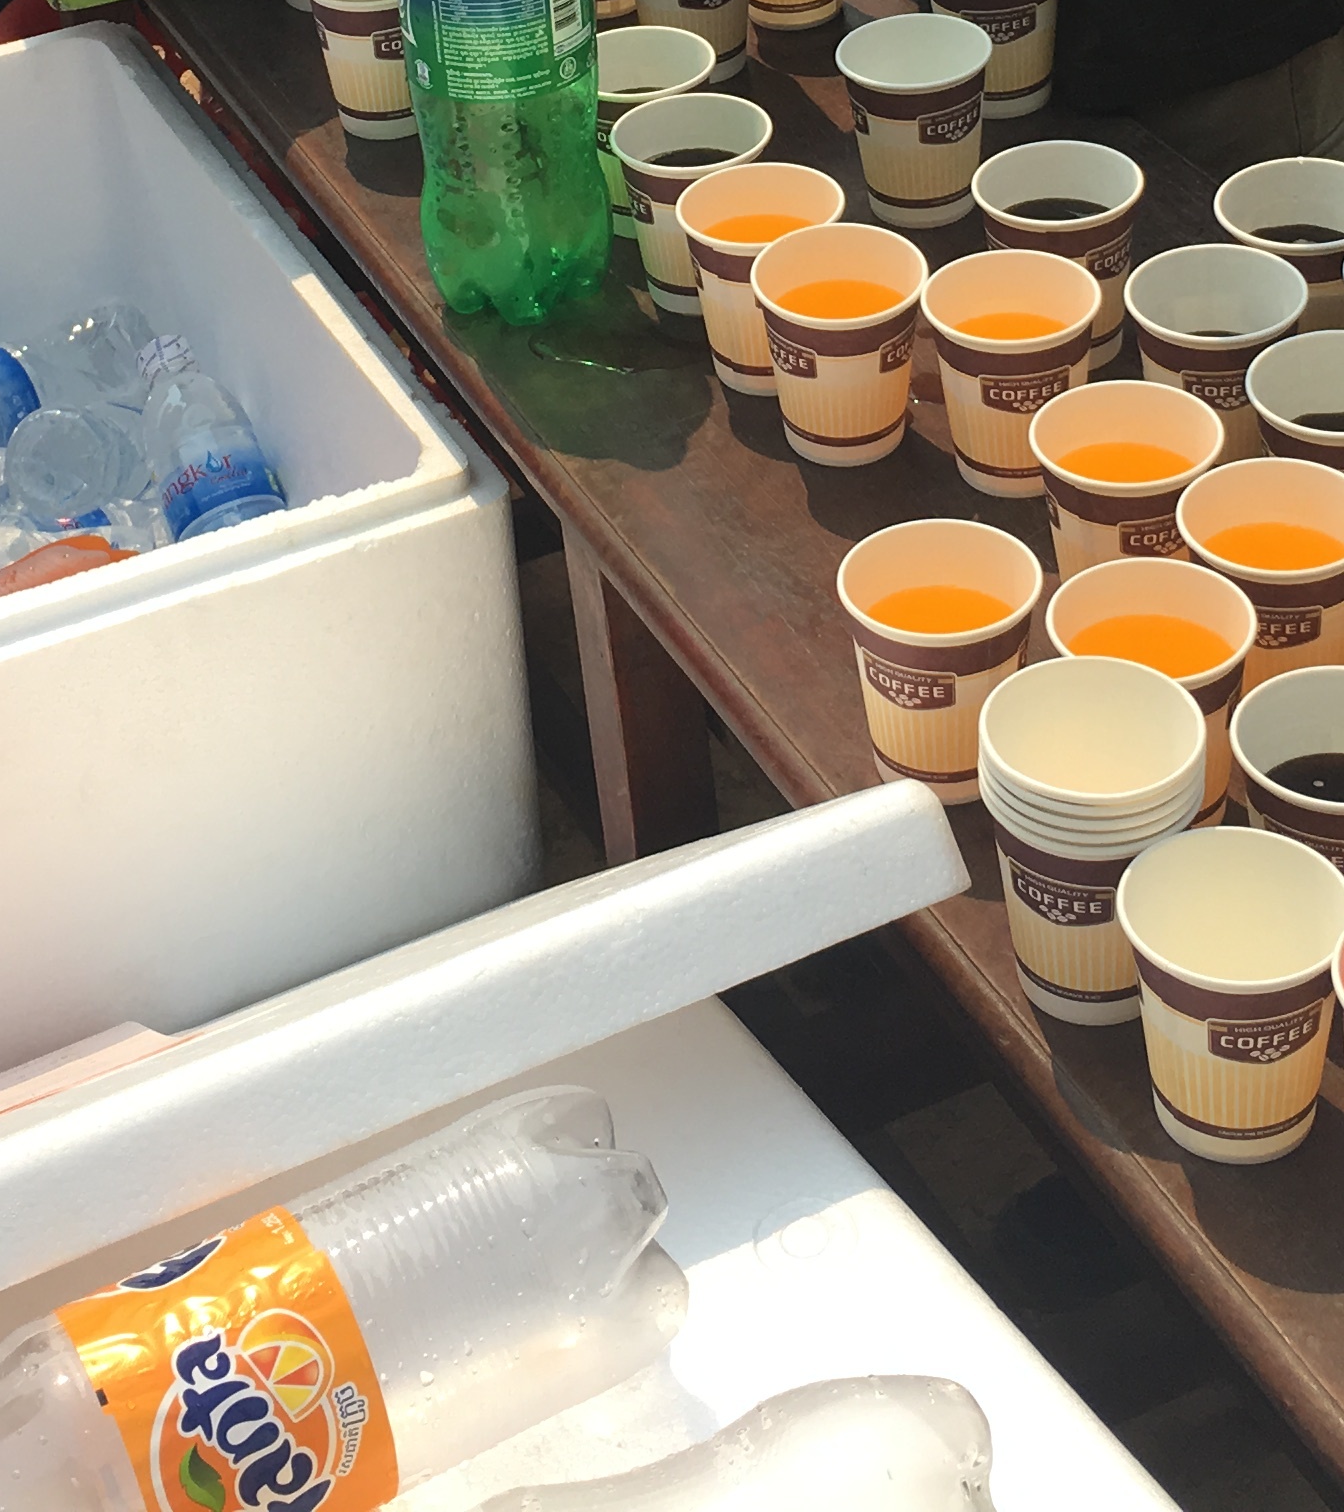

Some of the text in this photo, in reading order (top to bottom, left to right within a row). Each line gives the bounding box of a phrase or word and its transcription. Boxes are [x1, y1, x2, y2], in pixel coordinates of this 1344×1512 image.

[981, 17, 1031, 34] OFFEE
[926, 105, 979, 136] COFFEE
[989, 381, 1062, 401] COFFEE
[869, 666, 945, 698] COFFEE
[895, 671, 932, 684] QUALITY
[1017, 877, 1103, 914] COFFEE
[1047, 884, 1089, 898] QUALITY
[1220, 1018, 1314, 1049] COFFEE
[1234, 1016, 1305, 1034] HIGH QUALITY
